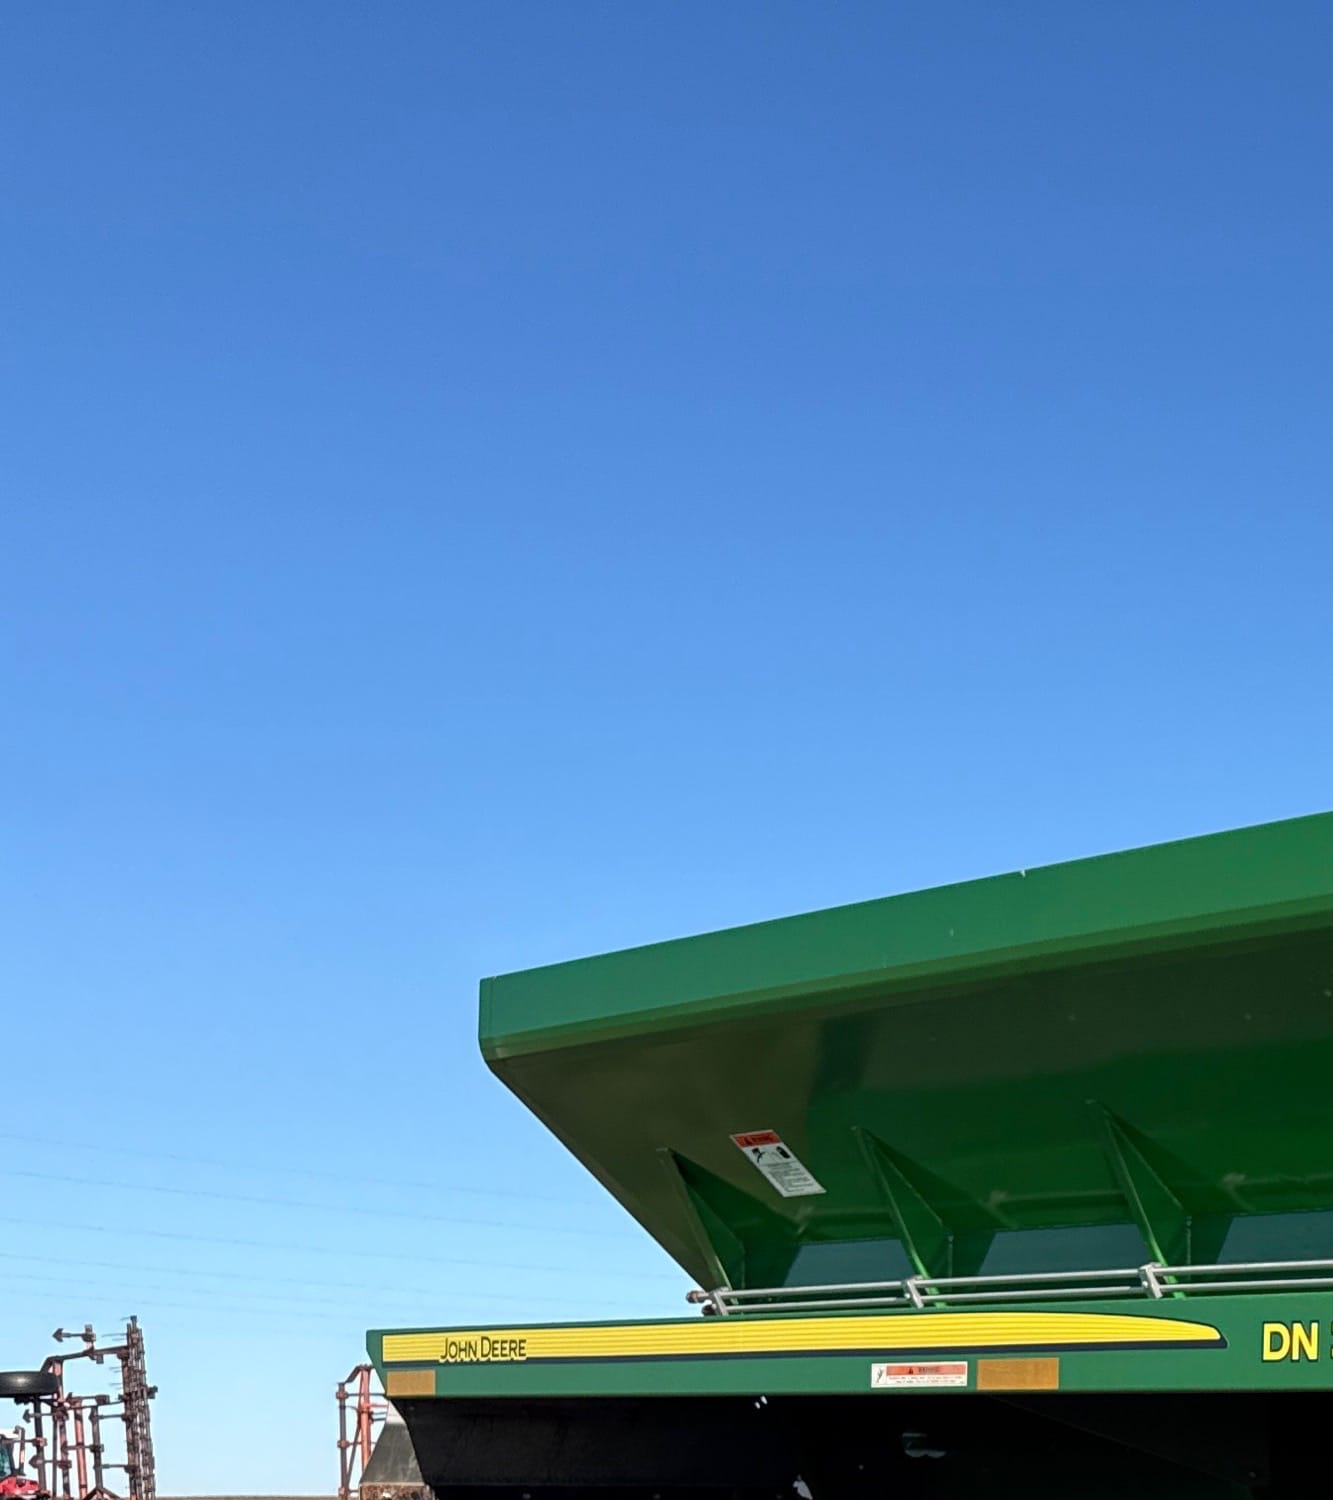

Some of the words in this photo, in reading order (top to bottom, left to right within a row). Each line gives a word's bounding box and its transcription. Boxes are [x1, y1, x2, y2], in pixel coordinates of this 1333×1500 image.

[440, 1337, 478, 1359] JOHN
[480, 1336, 527, 1358] DEERE
[1262, 1322, 1319, 1361] DN
